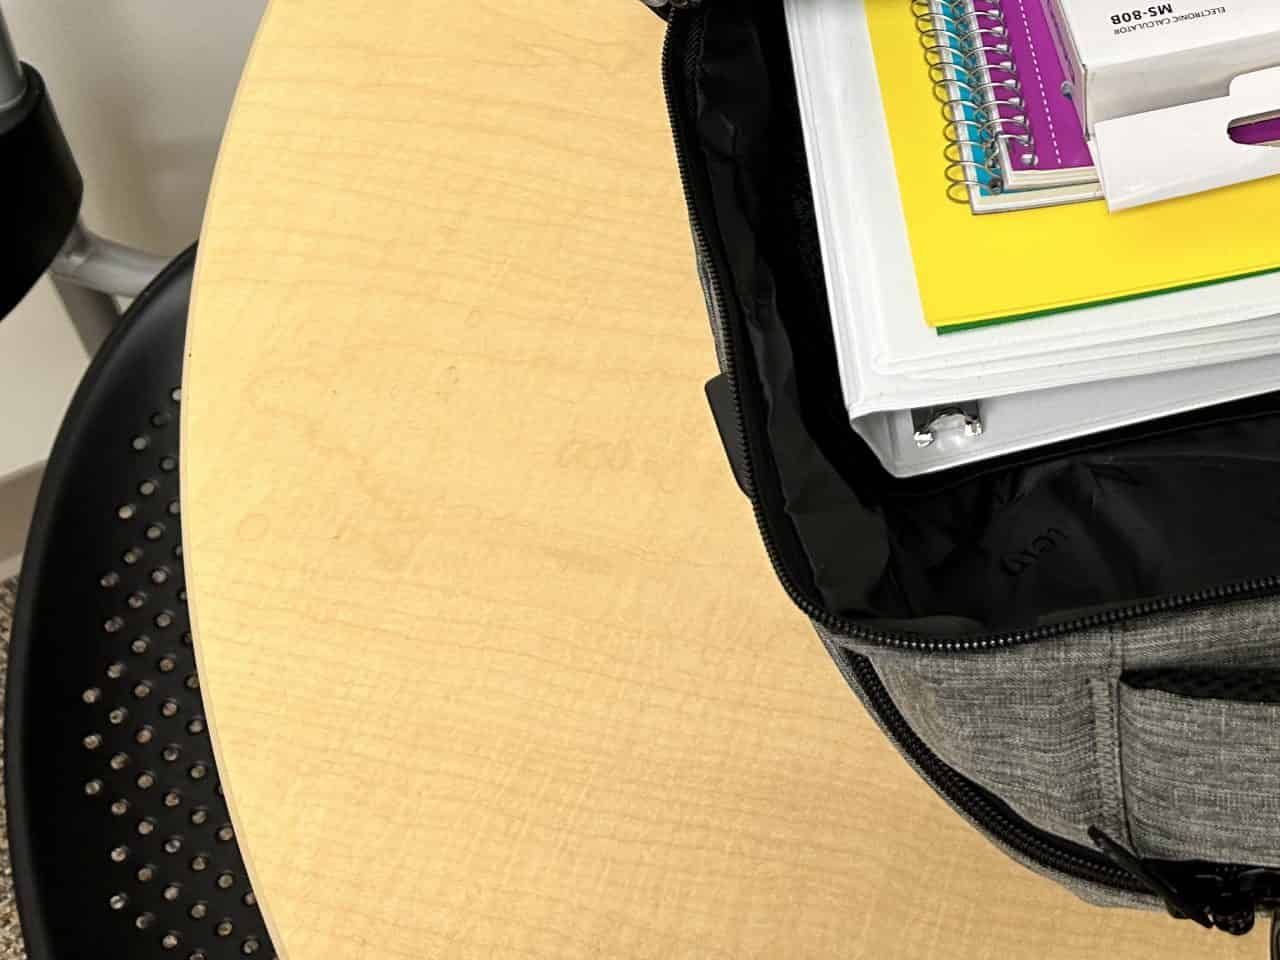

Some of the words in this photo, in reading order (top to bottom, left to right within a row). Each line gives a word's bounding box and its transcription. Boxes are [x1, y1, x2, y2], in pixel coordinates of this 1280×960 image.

[1110, 3, 1173, 25] MS-80B
[1169, 6, 1226, 25] ELECTRONIC
[1113, 18, 1171, 36] CALCULATOR
